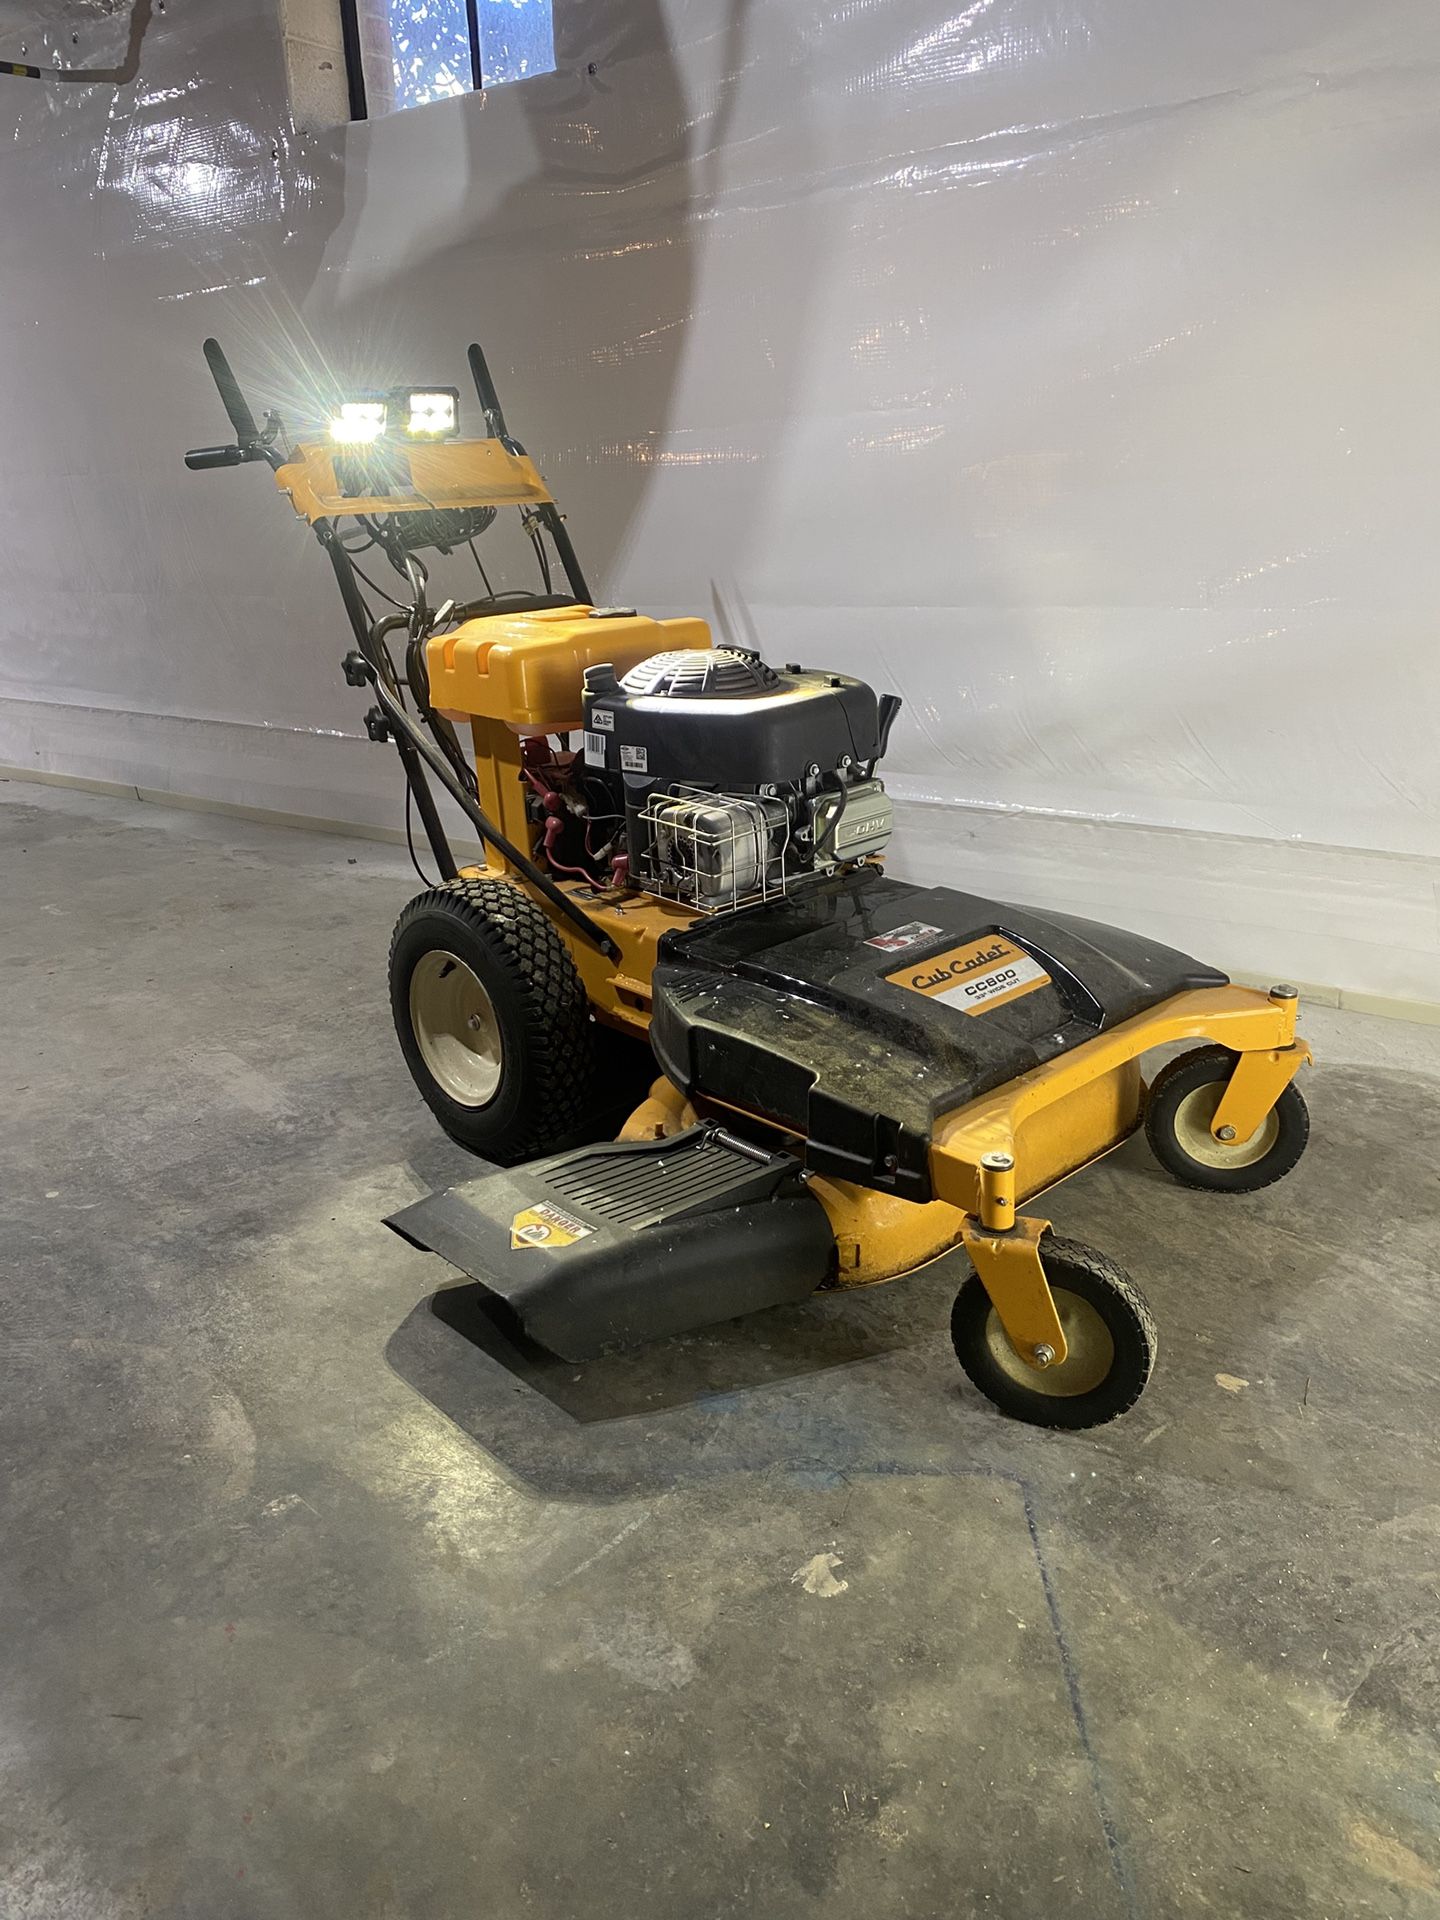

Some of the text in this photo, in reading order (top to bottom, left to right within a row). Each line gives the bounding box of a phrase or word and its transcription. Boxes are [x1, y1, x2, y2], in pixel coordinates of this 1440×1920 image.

[911, 943, 1012, 990] Cub Cadet
[964, 969, 1017, 996] CC800
[1006, 977, 1021, 987] CUT
[539, 1208, 582, 1234] DANGER
